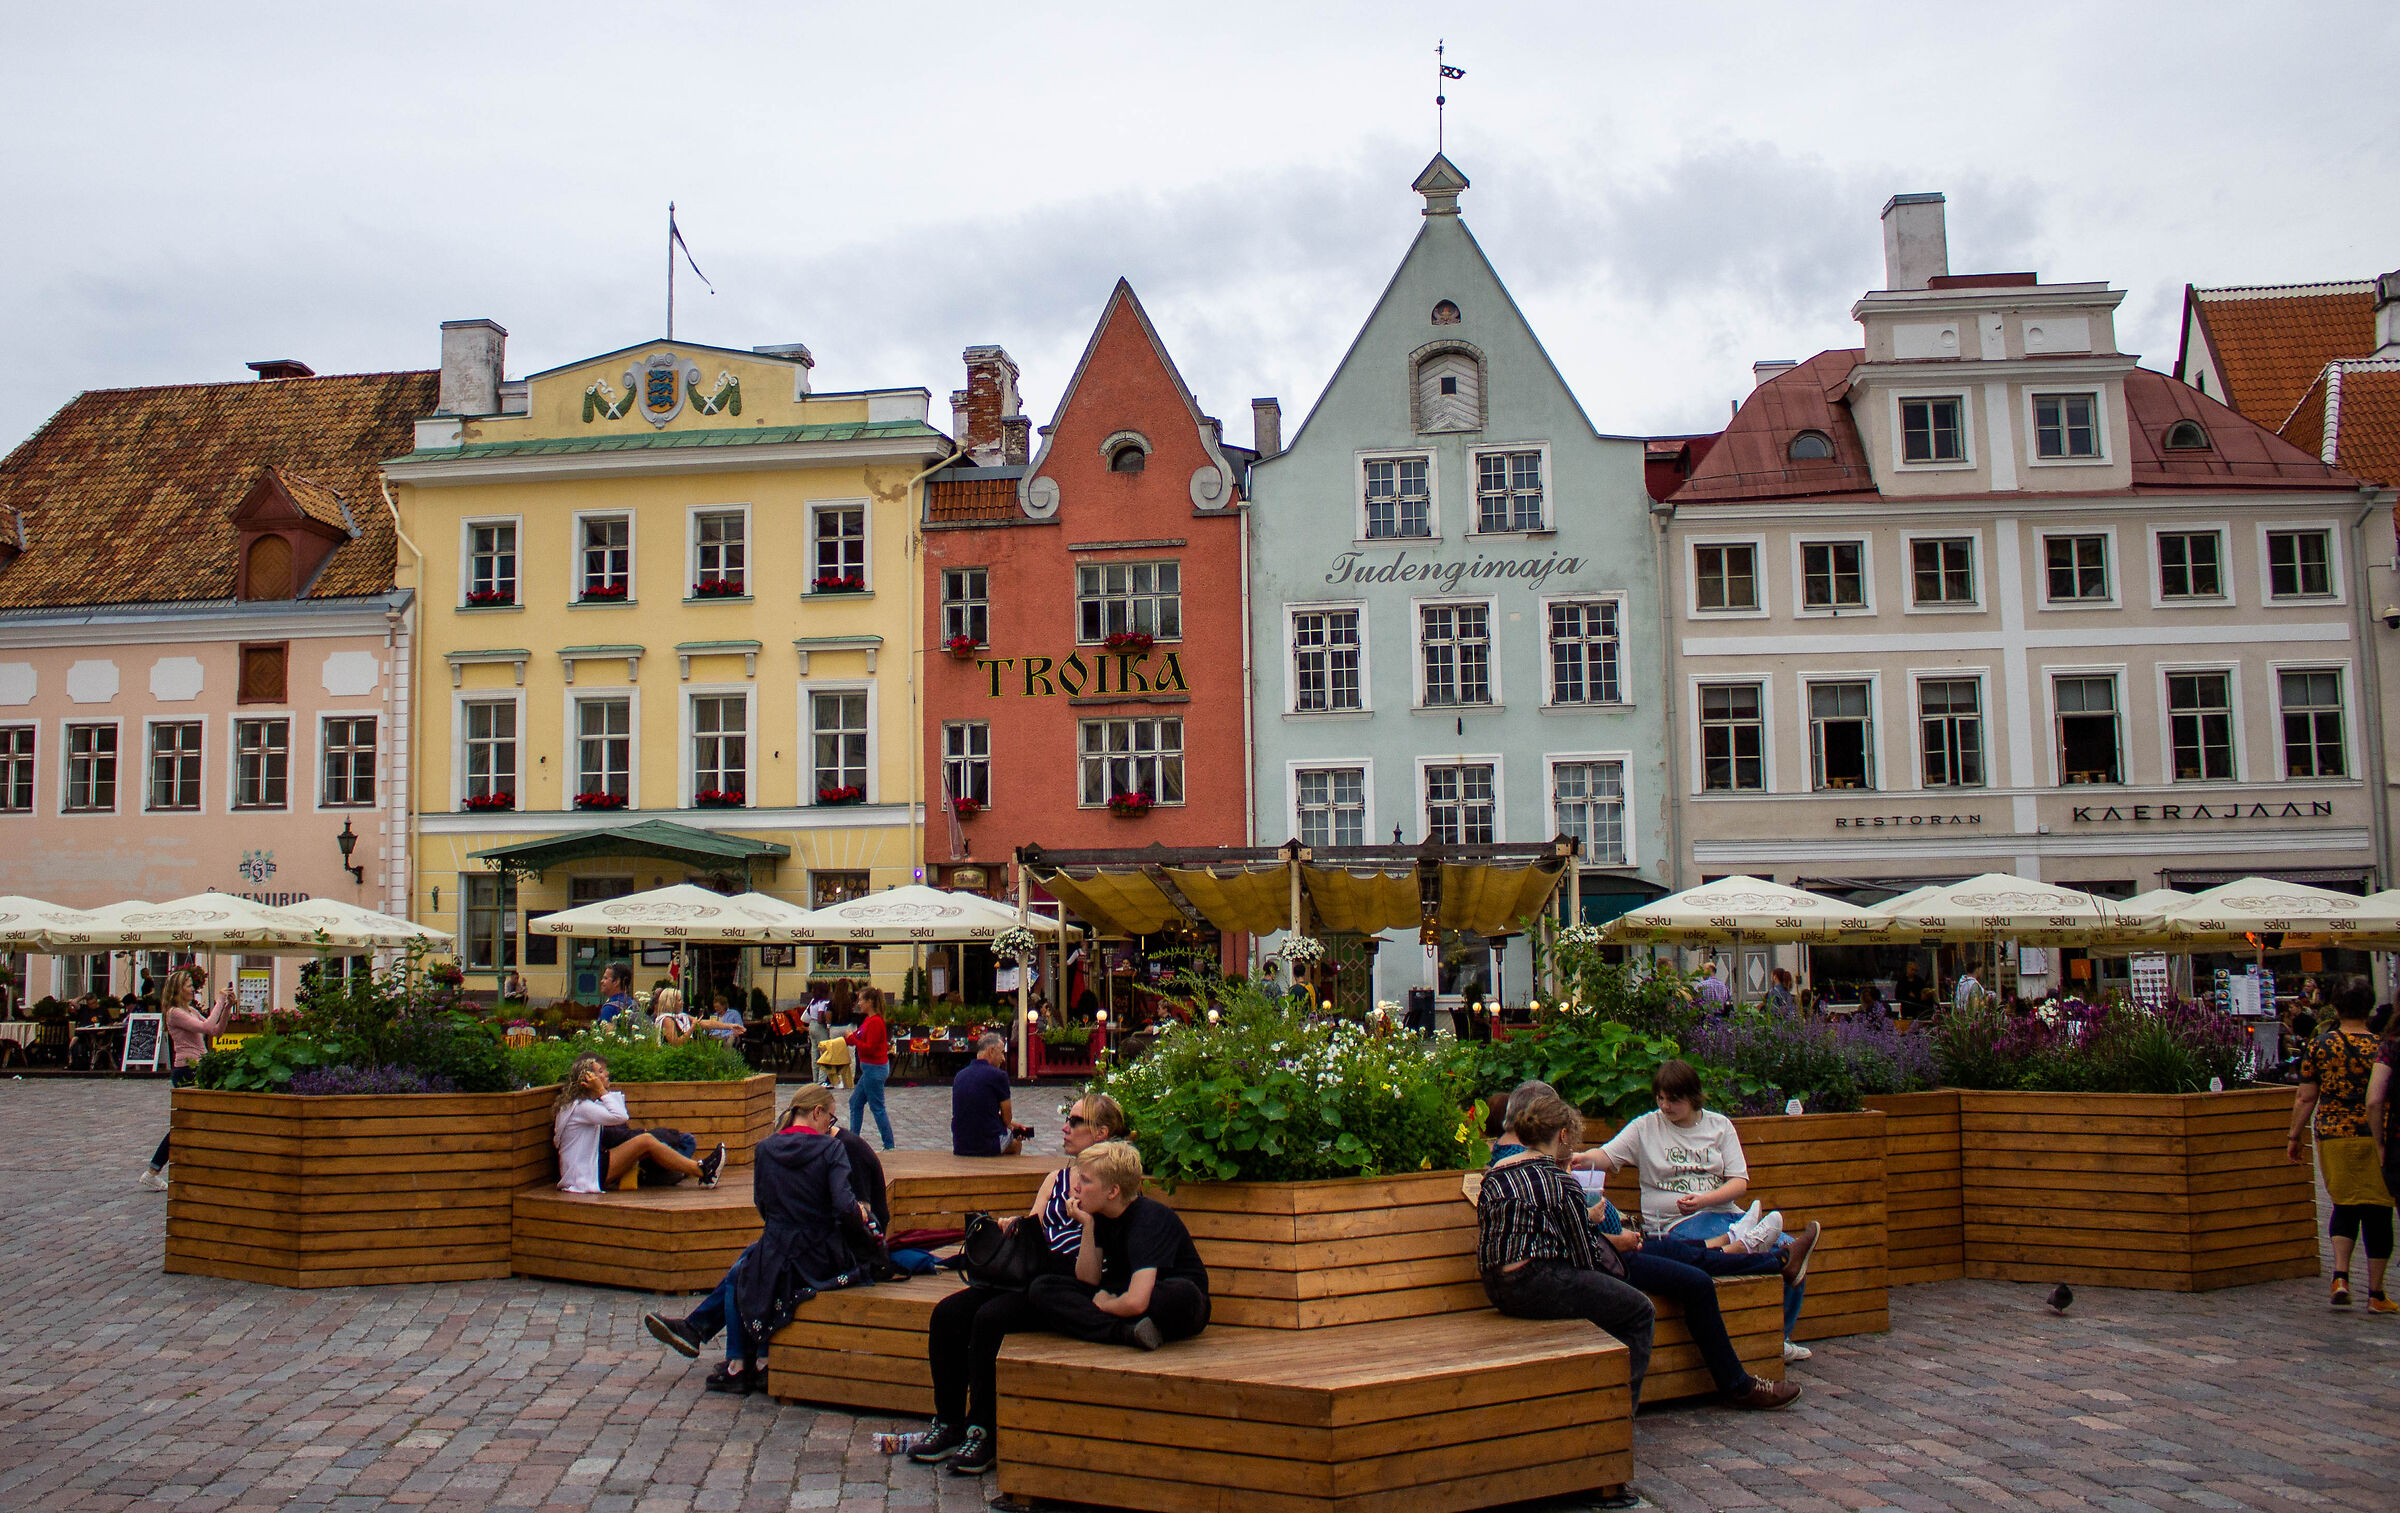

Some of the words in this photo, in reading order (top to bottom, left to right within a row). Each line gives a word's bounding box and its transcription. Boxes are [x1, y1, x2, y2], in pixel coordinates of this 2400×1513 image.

[1325, 551, 1588, 593] Tudengimaja
[976, 650, 1190, 698] TROIKA
[2073, 801, 2332, 822] KAERAJAAN
[1836, 814, 1981, 827] RESTORAN
[1645, 915, 1672, 926] saku
[1710, 916, 1737, 927] saku
[1775, 916, 1802, 927] saku
[1841, 917, 1868, 928] saku
[1920, 915, 1946, 927] saku
[1984, 915, 2011, 927] saku
[2049, 915, 2076, 927] saku
[2115, 915, 2142, 926] saku
[2199, 919, 2226, 930] saku
[2264, 918, 2291, 930] saku
[2329, 918, 2357, 930] saku
[5, 930, 26, 940] saku
[69, 933, 91, 943] saku
[120, 931, 142, 942] saku
[171, 930, 193, 940] saku
[223, 928, 246, 939] saku
[550, 922, 574, 933] saku
[607, 924, 630, 935] saku
[664, 925, 687, 936] saku
[722, 927, 745, 937] saku
[790, 927, 815, 938] saku
[850, 927, 874, 938] saku
[910, 927, 934, 938] saku
[970, 926, 995, 937] saku
